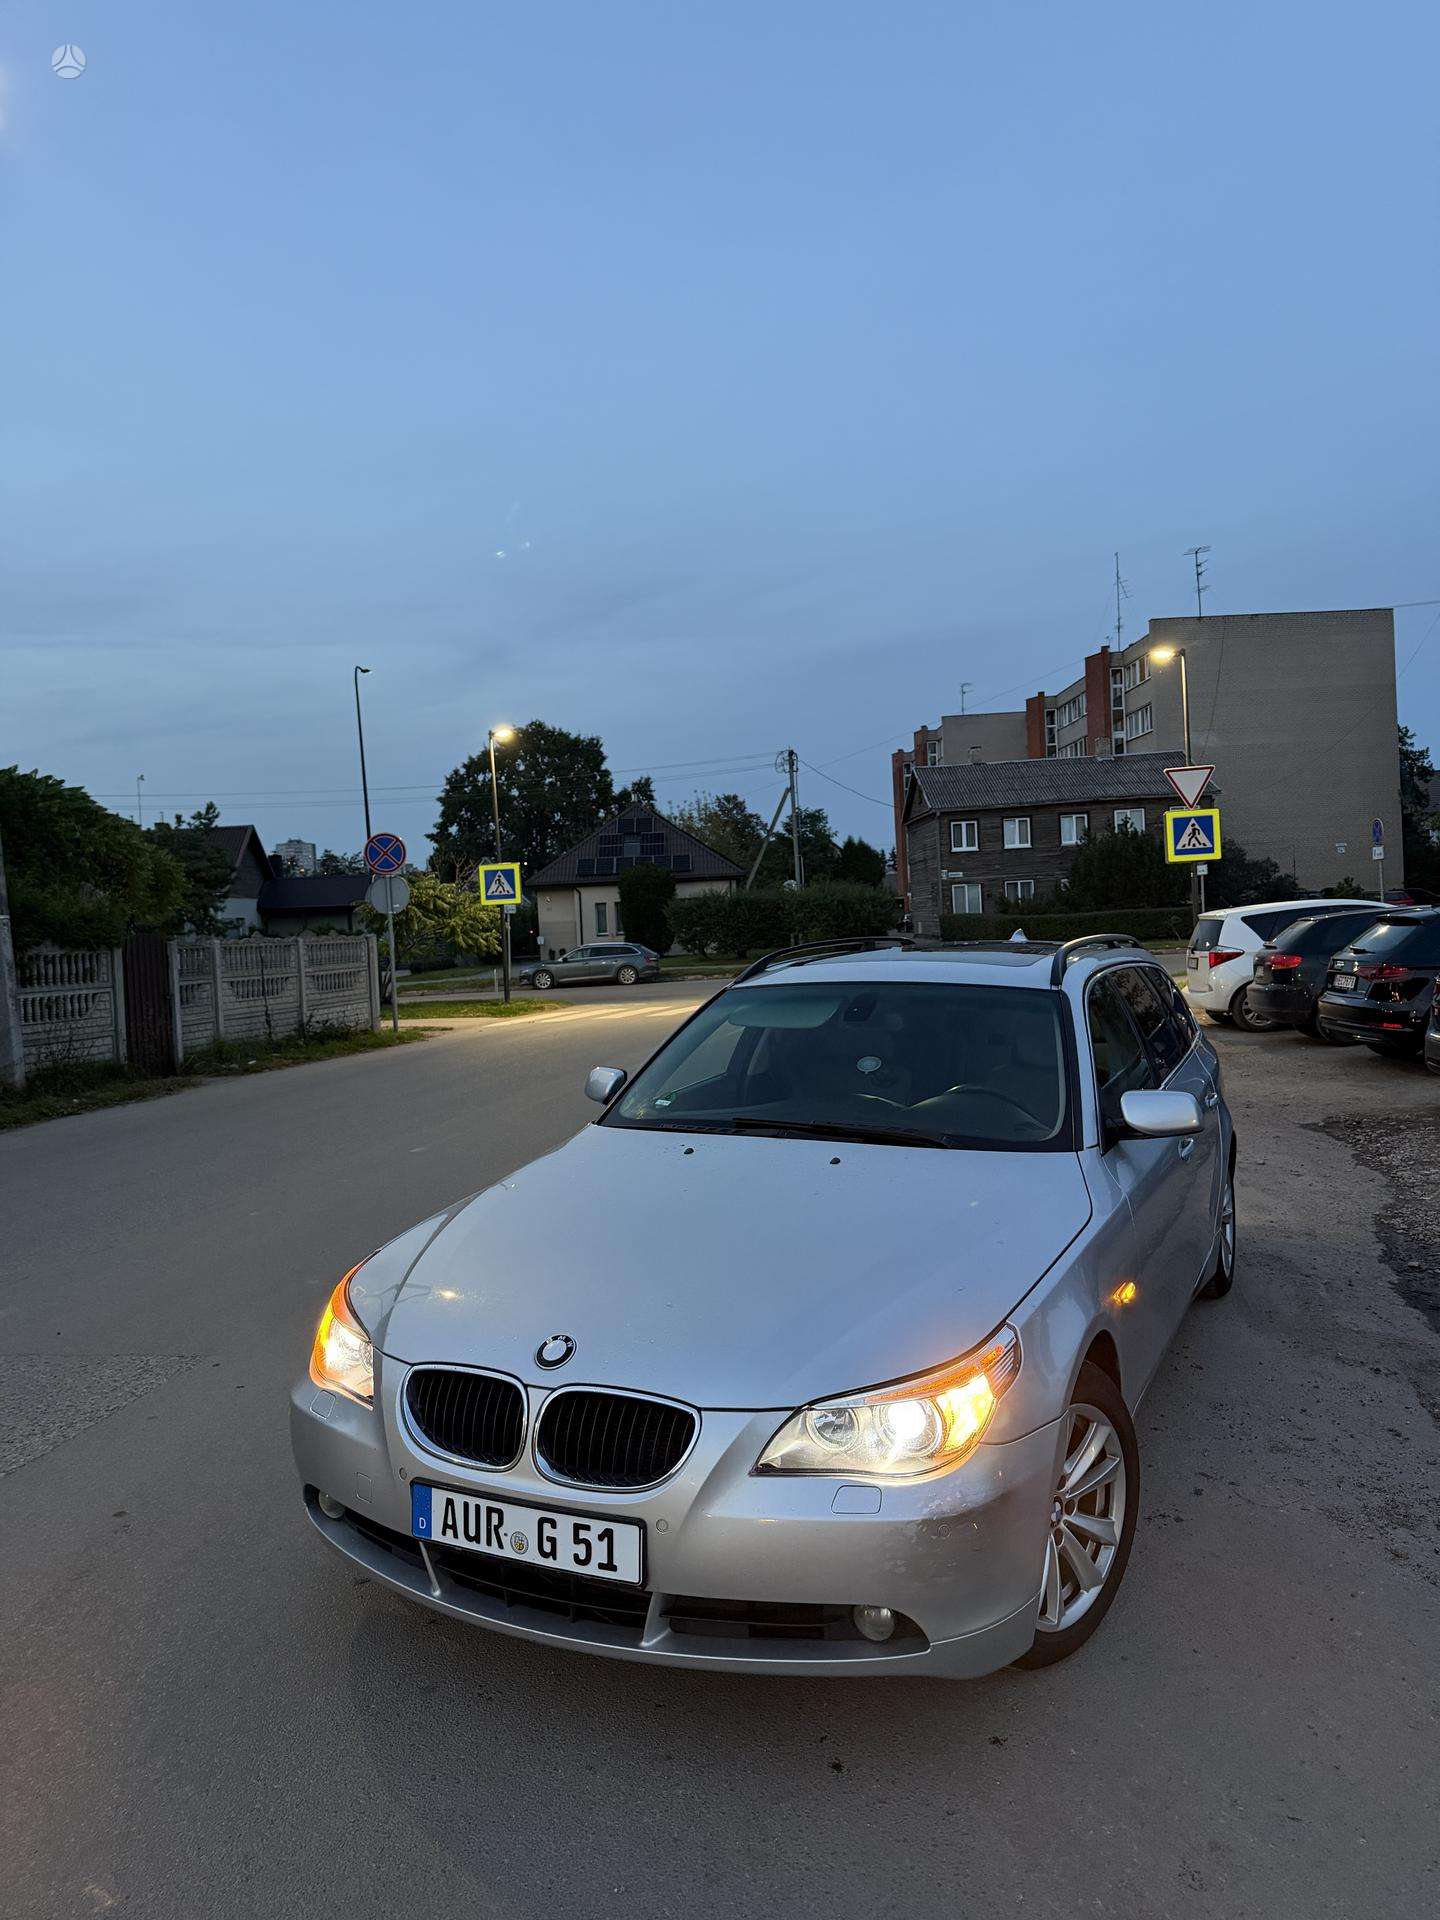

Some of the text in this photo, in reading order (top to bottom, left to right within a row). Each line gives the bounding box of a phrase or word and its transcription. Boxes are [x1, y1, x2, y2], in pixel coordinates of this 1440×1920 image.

[418, 1517, 427, 1529] D
[441, 1497, 618, 1572] AUR G 51
